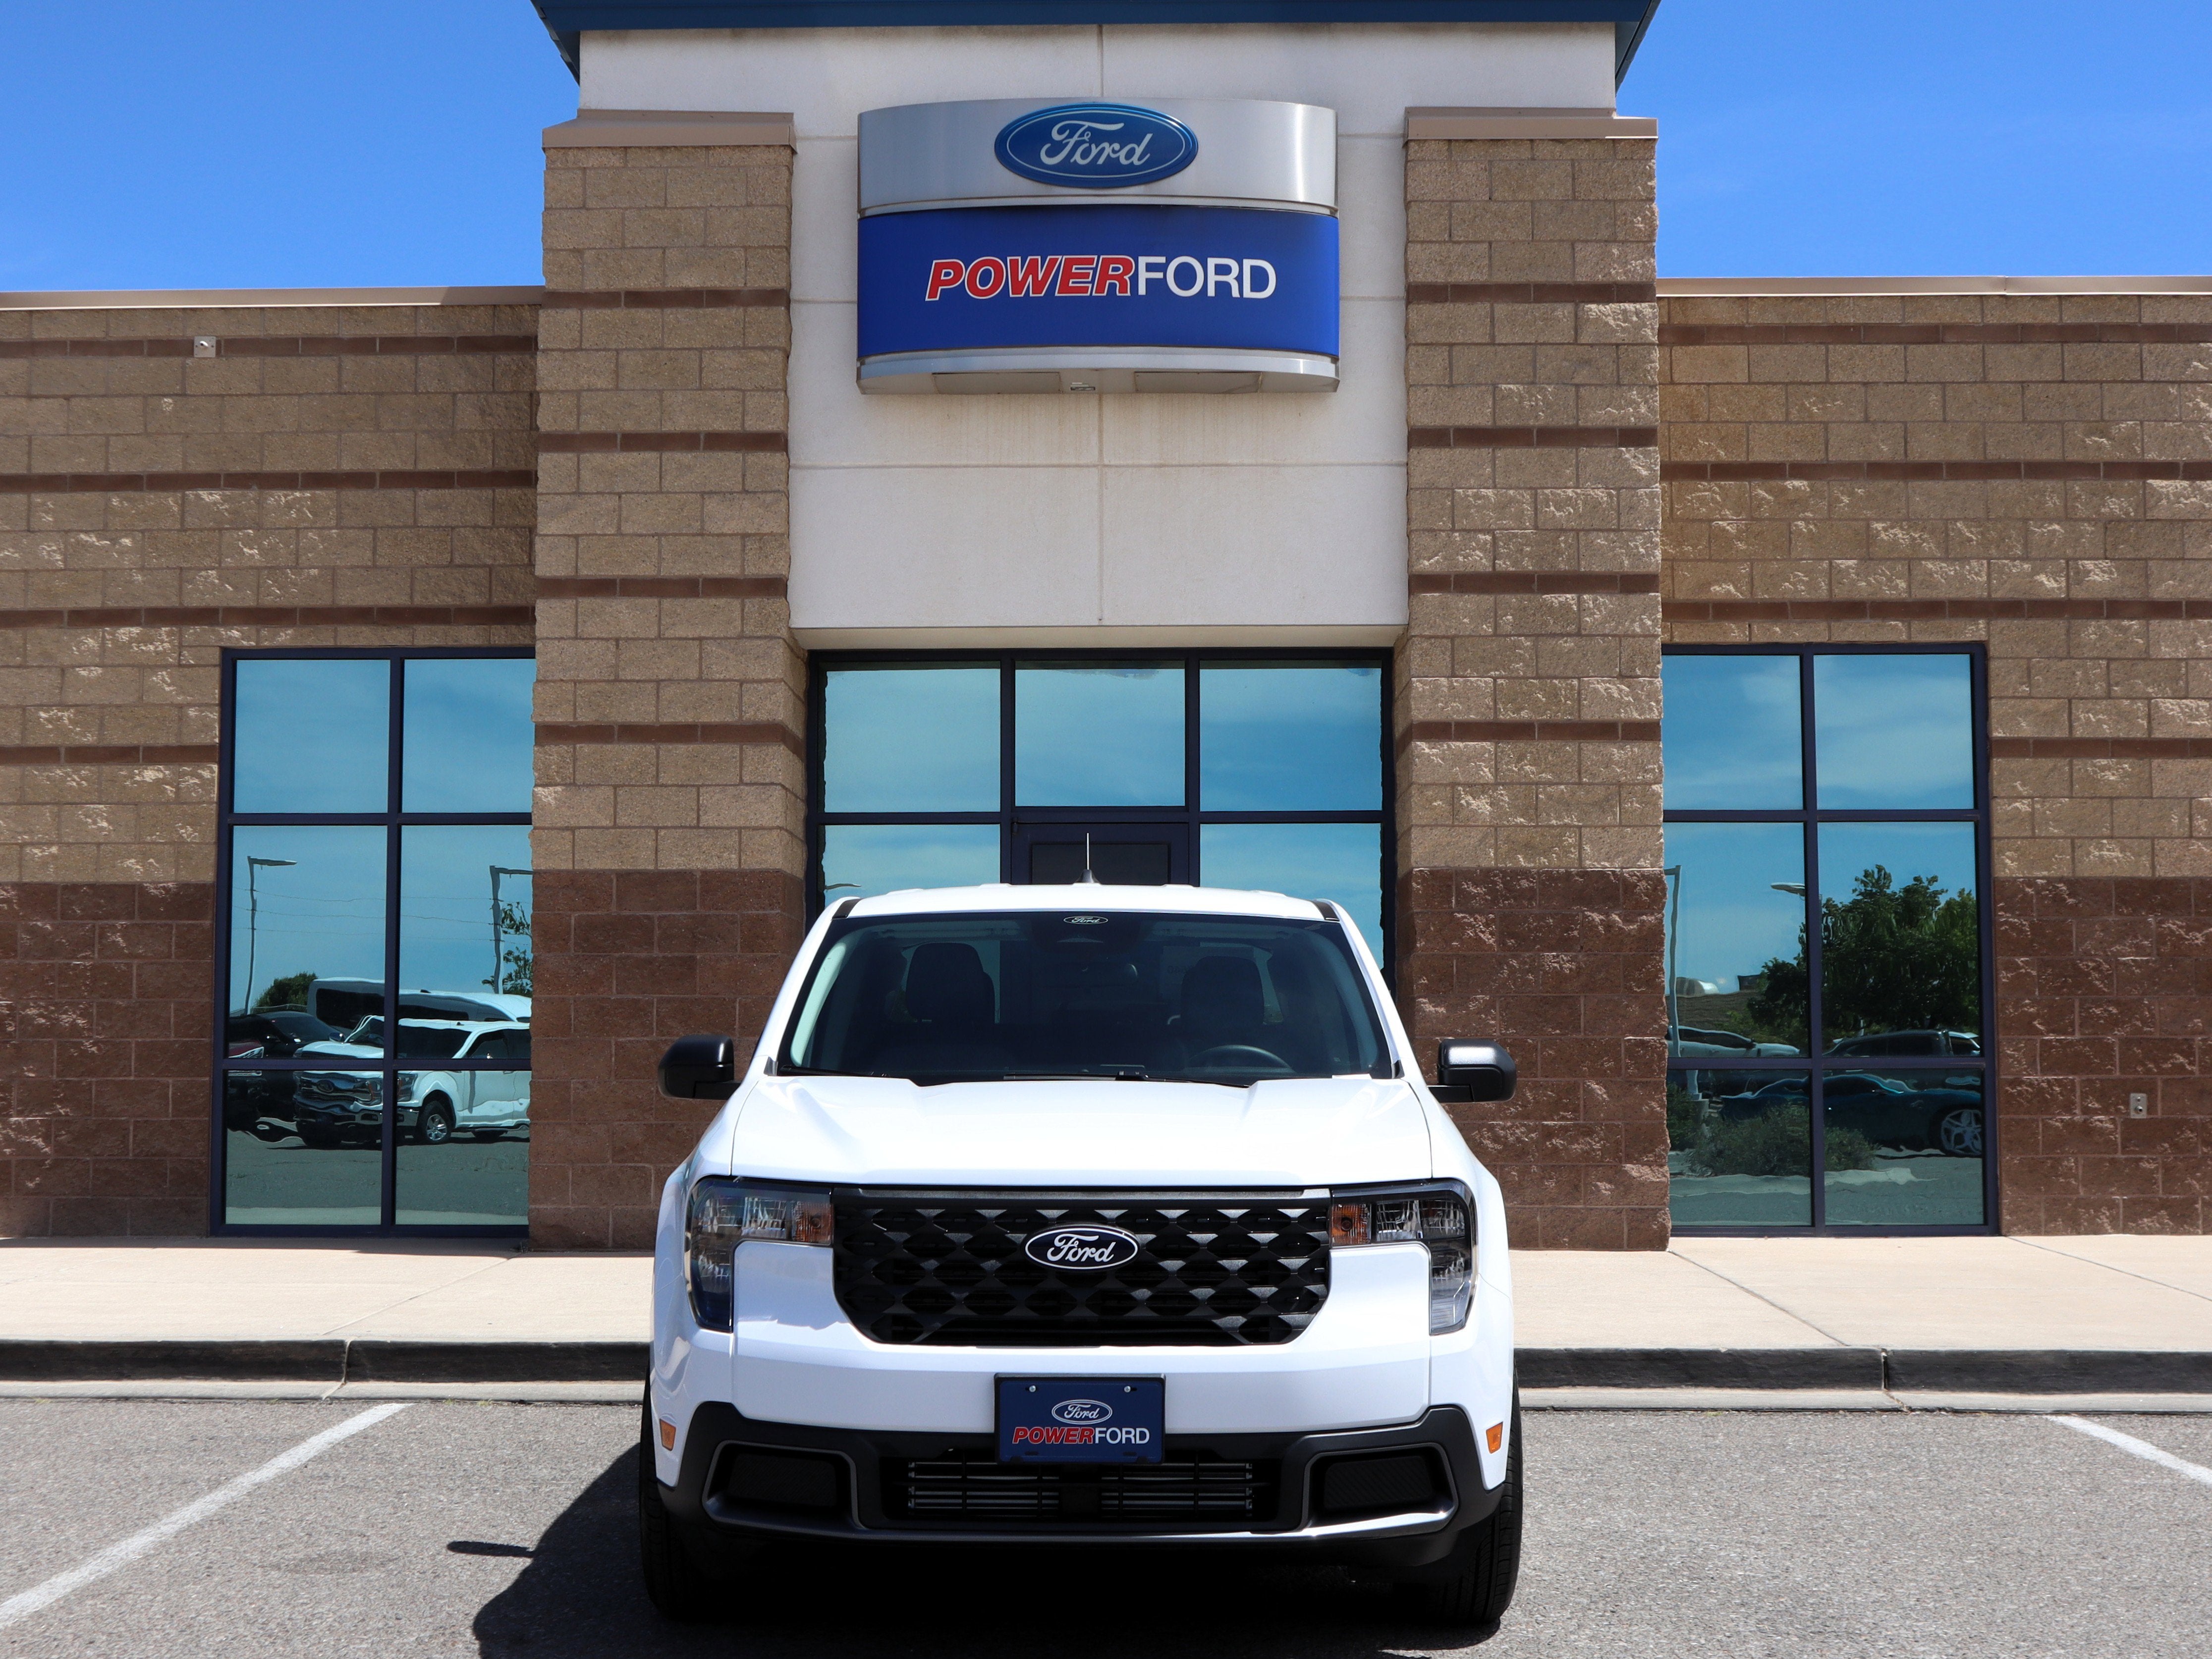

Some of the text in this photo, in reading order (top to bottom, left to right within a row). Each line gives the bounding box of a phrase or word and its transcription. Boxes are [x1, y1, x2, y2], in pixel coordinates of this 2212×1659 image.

[1040, 120, 1153, 166] Ford
[1047, 1233, 1116, 1262] Ford
[1064, 1404, 1100, 1419] Ford
